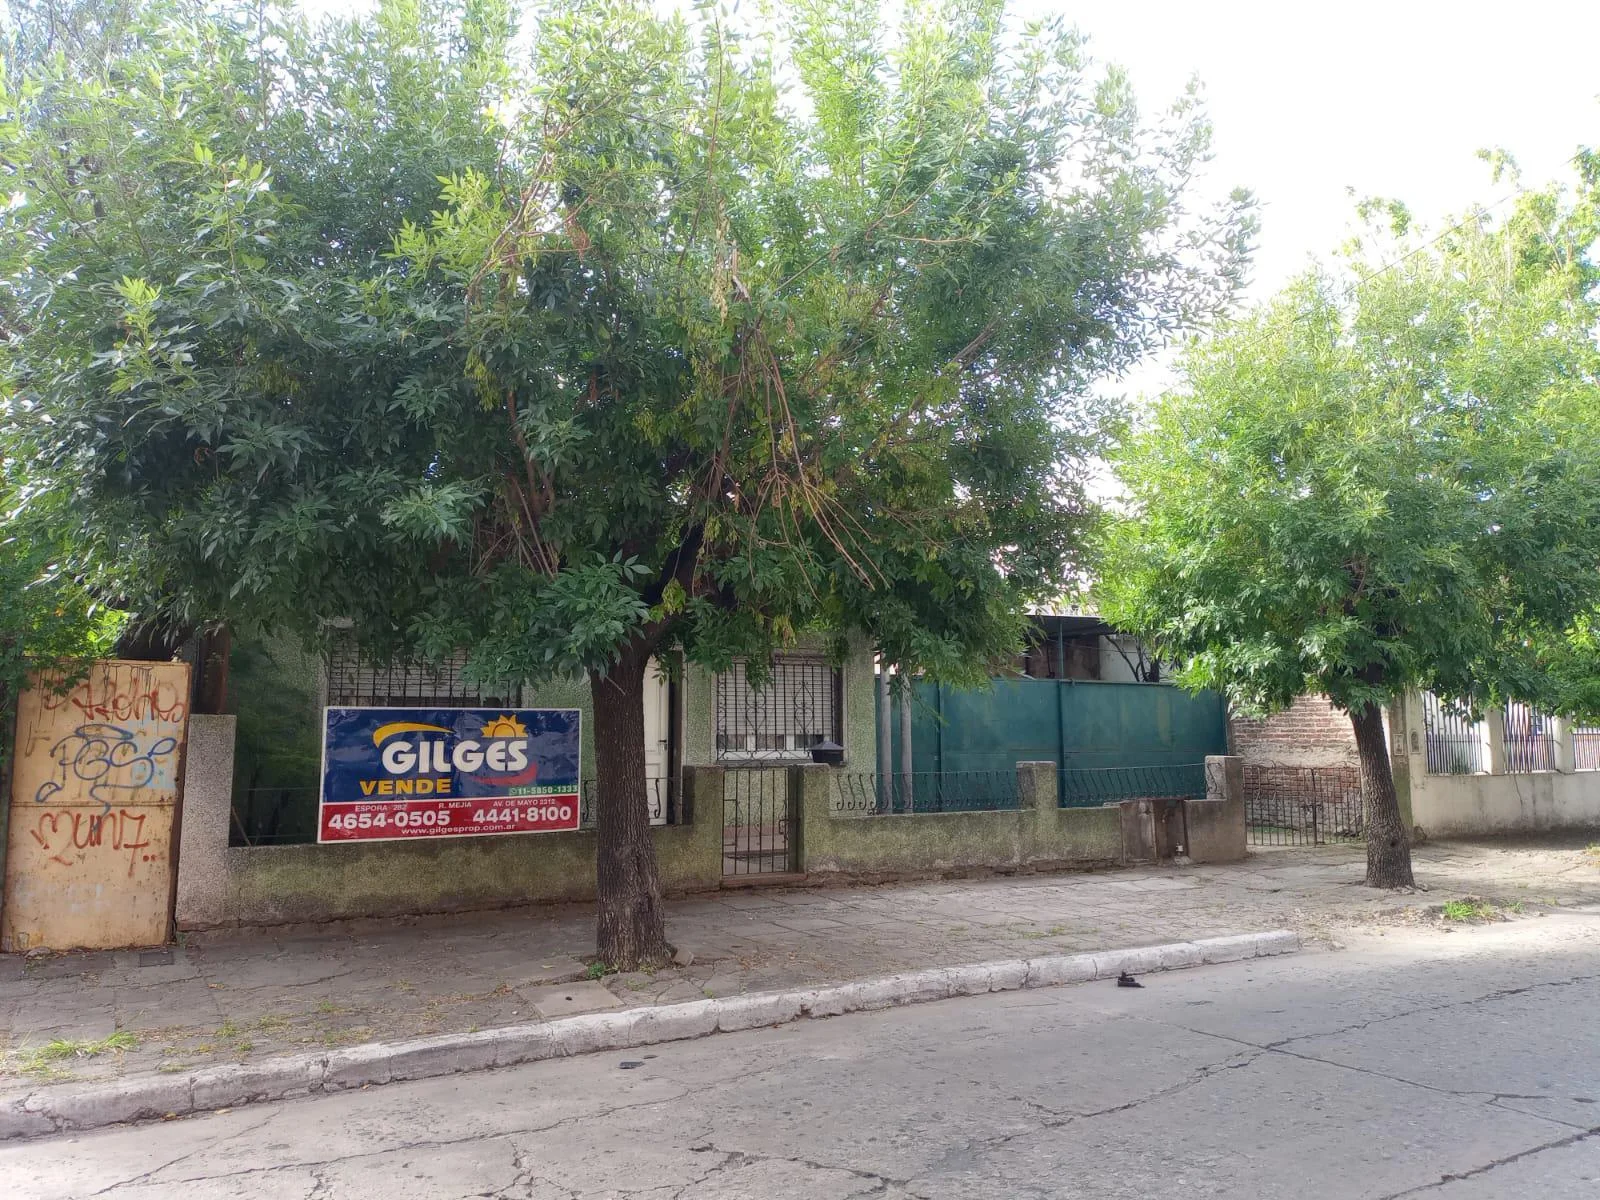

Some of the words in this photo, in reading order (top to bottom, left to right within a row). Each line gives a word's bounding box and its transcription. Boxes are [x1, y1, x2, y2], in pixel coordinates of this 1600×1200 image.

[381, 739, 529, 774] GILGES
[359, 778, 452, 796] VENDE
[354, 804, 388, 813] ESPORA
[472, 806, 572, 824] 4441-8100
[327, 810, 451, 830] 4654-0505
[401, 824, 516, 836] www.gilgesprop.com.ar
